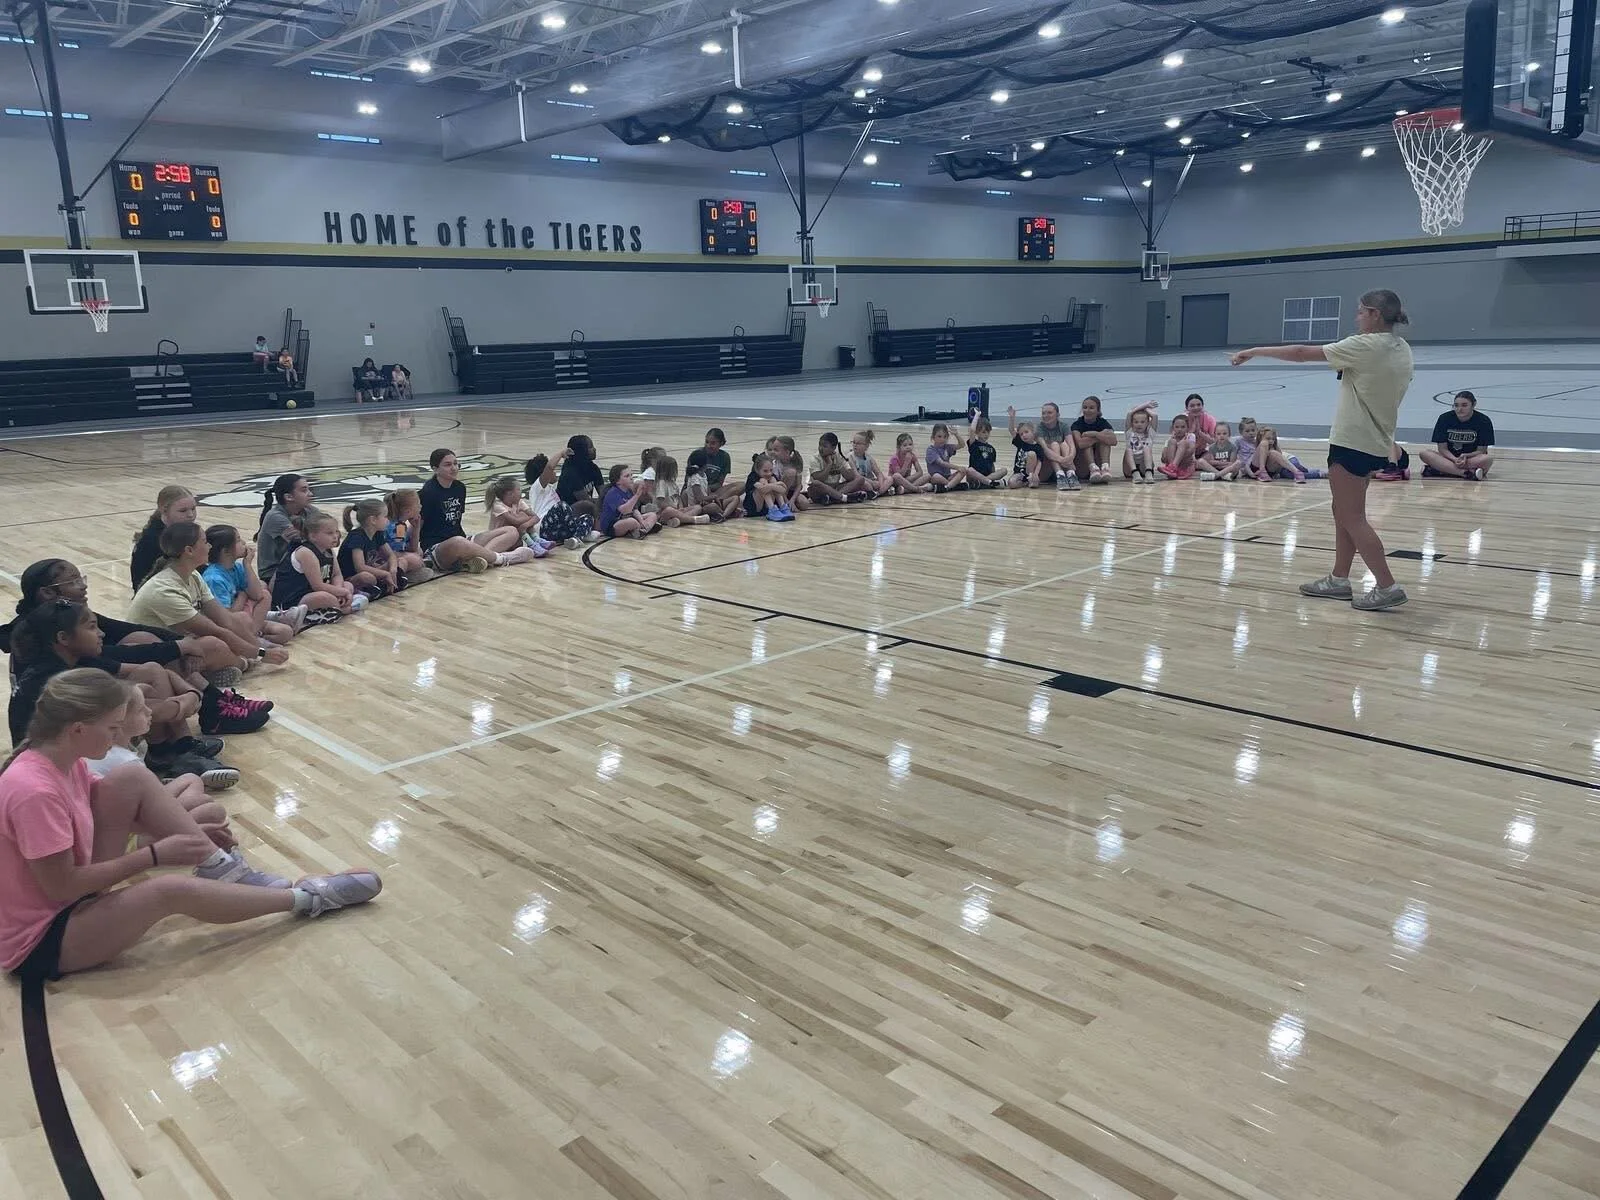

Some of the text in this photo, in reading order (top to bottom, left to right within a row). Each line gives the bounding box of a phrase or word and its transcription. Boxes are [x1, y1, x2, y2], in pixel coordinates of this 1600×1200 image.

[119, 164, 137, 172] Home
[155, 164, 191, 184] 2:58
[195, 168, 216, 177] Guests
[130, 173, 144, 191] 0
[207, 177, 220, 195] 0
[161, 192, 181, 200] period
[190, 190, 195, 202] 1
[162, 203, 183, 211] player
[128, 212, 139, 226] 0
[712, 208, 718, 220] 0
[750, 210, 756, 222] 0
[211, 215, 221, 228] 0
[324, 211, 642, 252] HOME of the TIGERS
[709, 236, 714, 244] 0
[750, 237, 755, 246] 0
